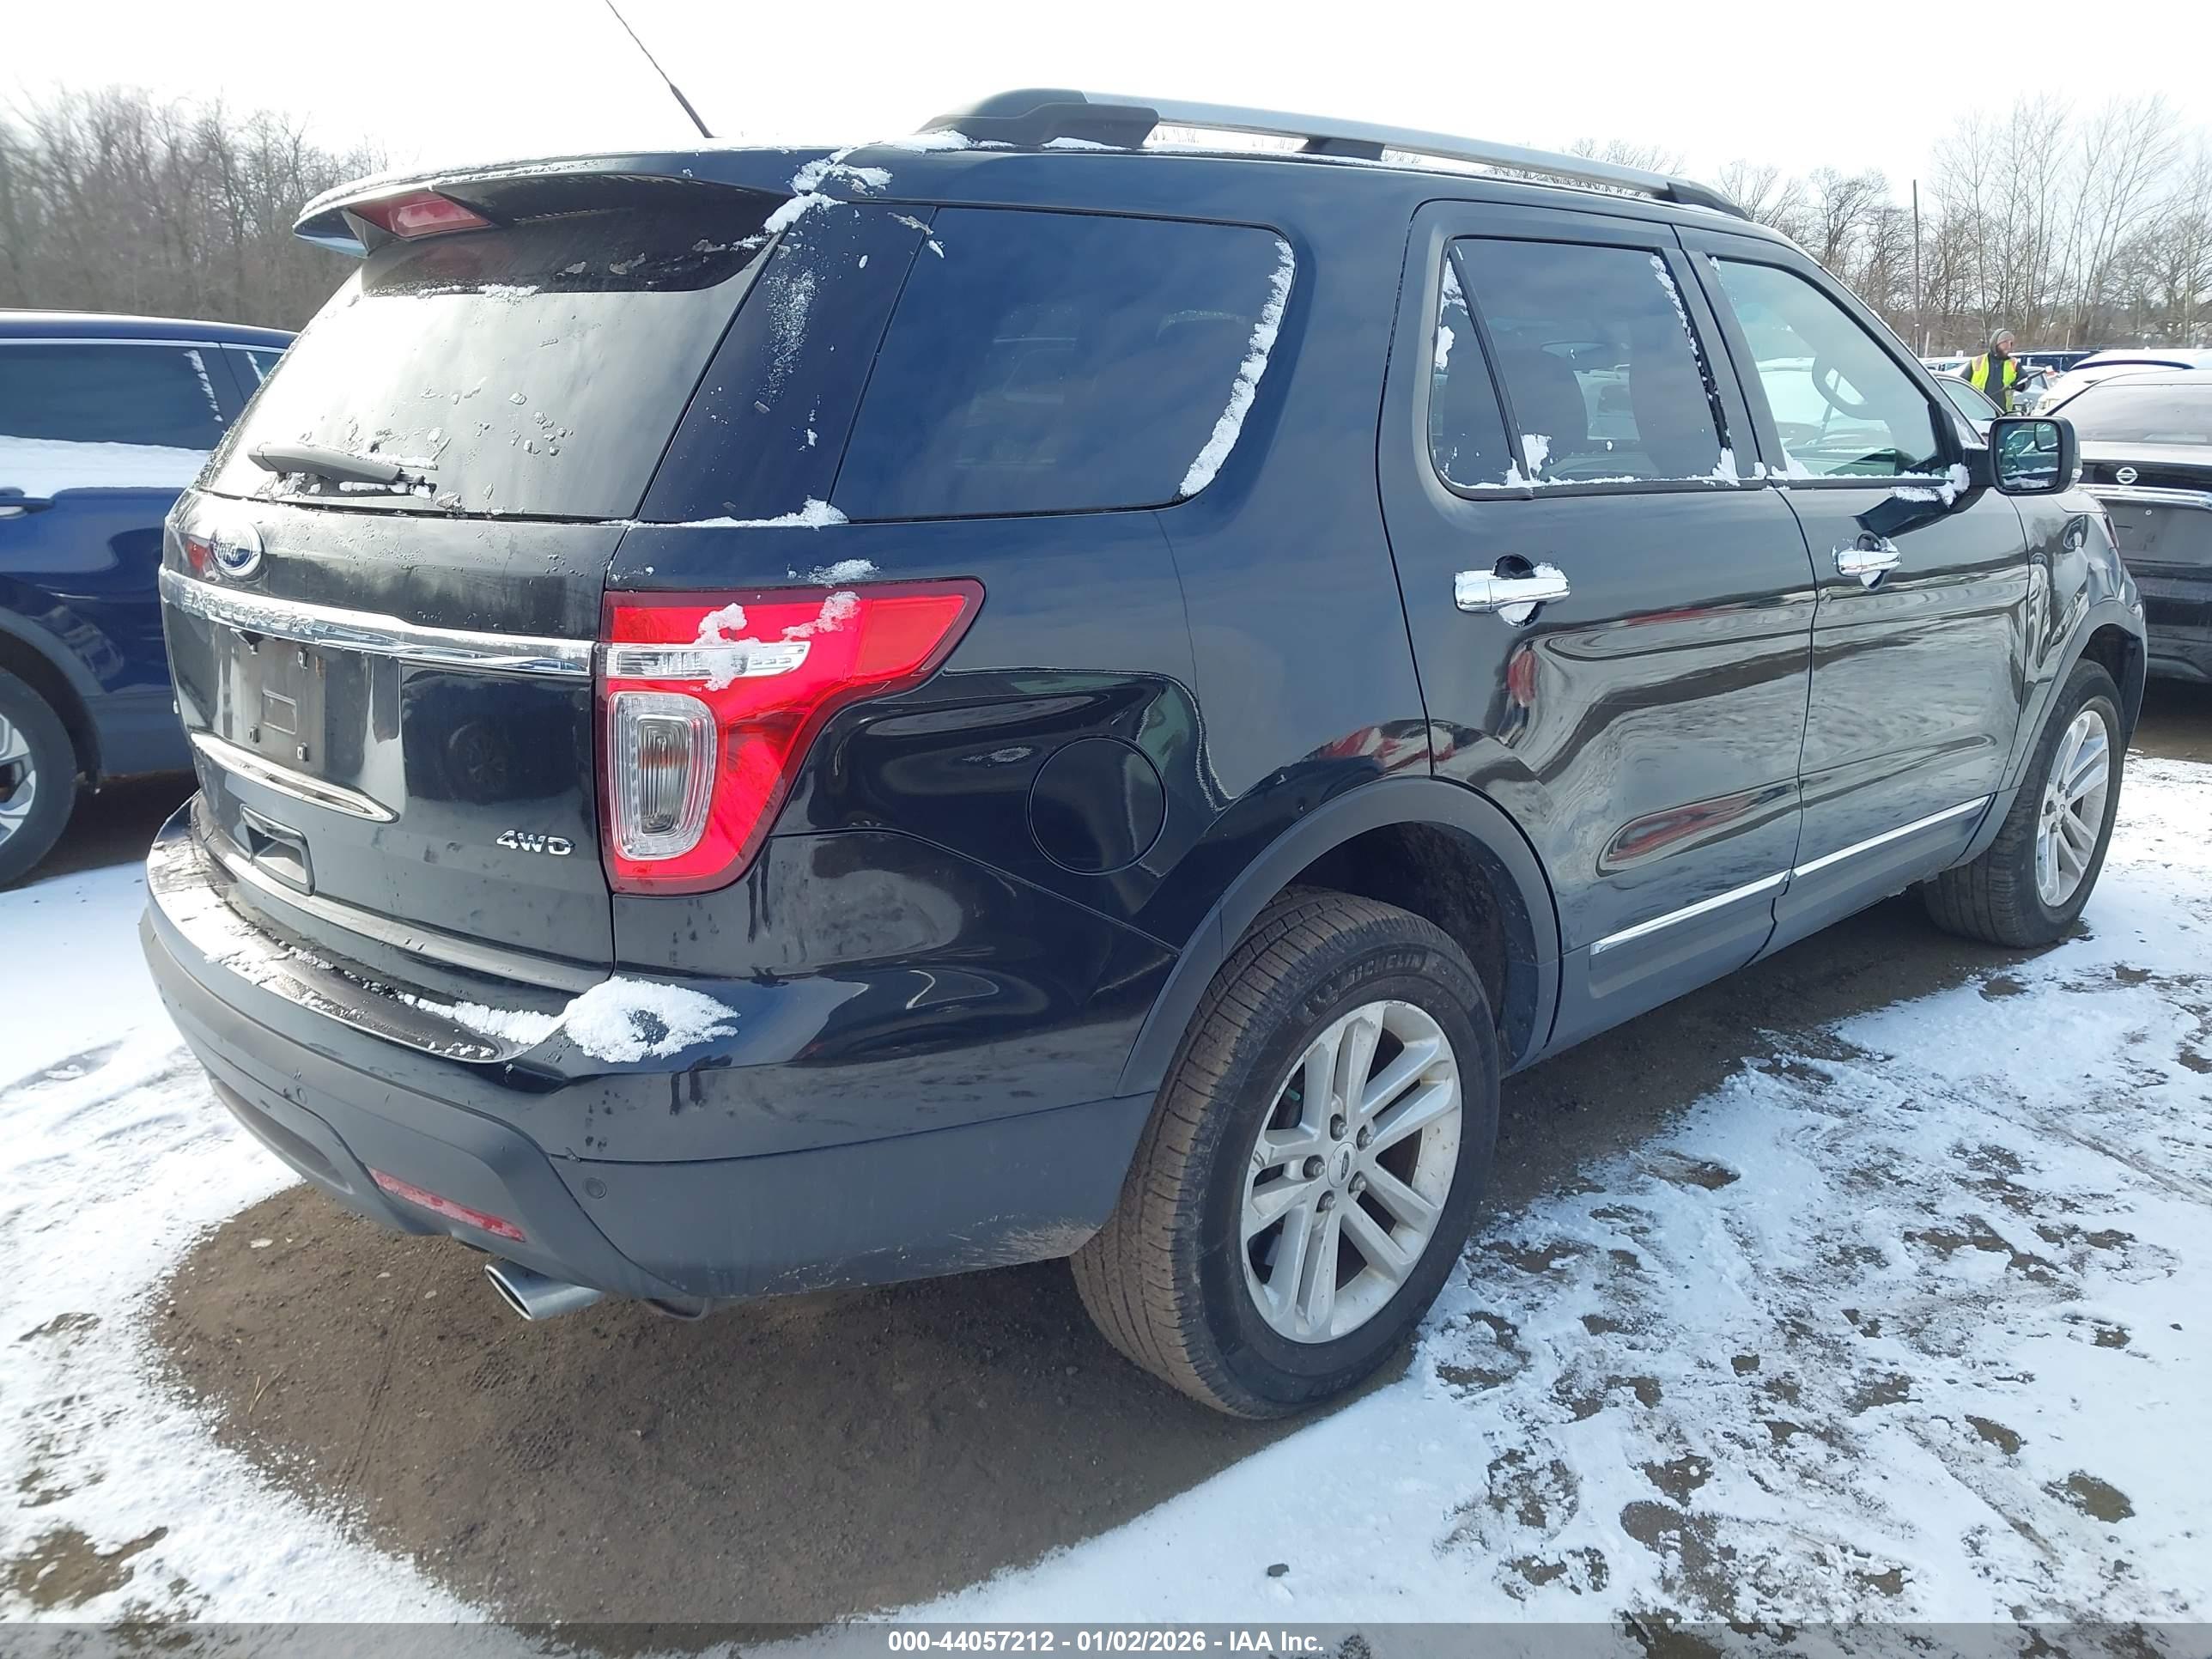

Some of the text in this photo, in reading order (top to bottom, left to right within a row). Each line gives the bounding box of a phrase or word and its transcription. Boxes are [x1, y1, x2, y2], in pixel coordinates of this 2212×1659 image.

[181, 582, 316, 635] EXPLORER
[495, 829, 574, 855] 4WD
[1342, 954, 1423, 988] MICHELIN
